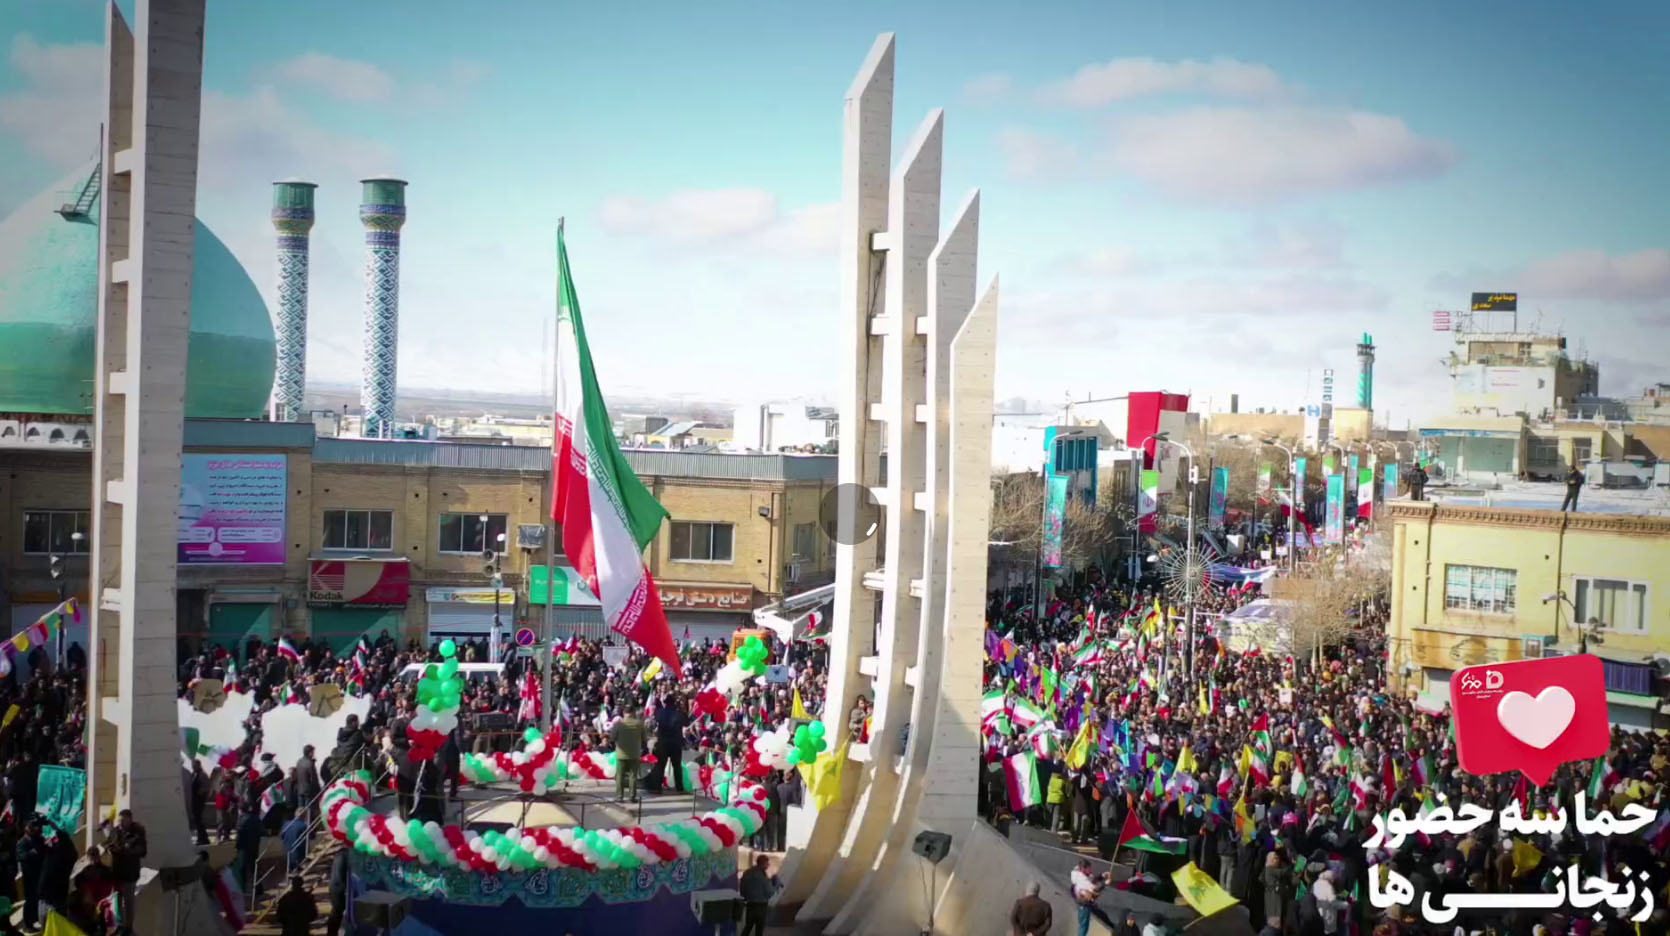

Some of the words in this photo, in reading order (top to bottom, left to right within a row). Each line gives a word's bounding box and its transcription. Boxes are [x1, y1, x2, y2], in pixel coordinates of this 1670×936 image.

[310, 591, 343, 600] Kodak
[686, 591, 716, 607] دستی
[717, 590, 748, 608] صنایع
